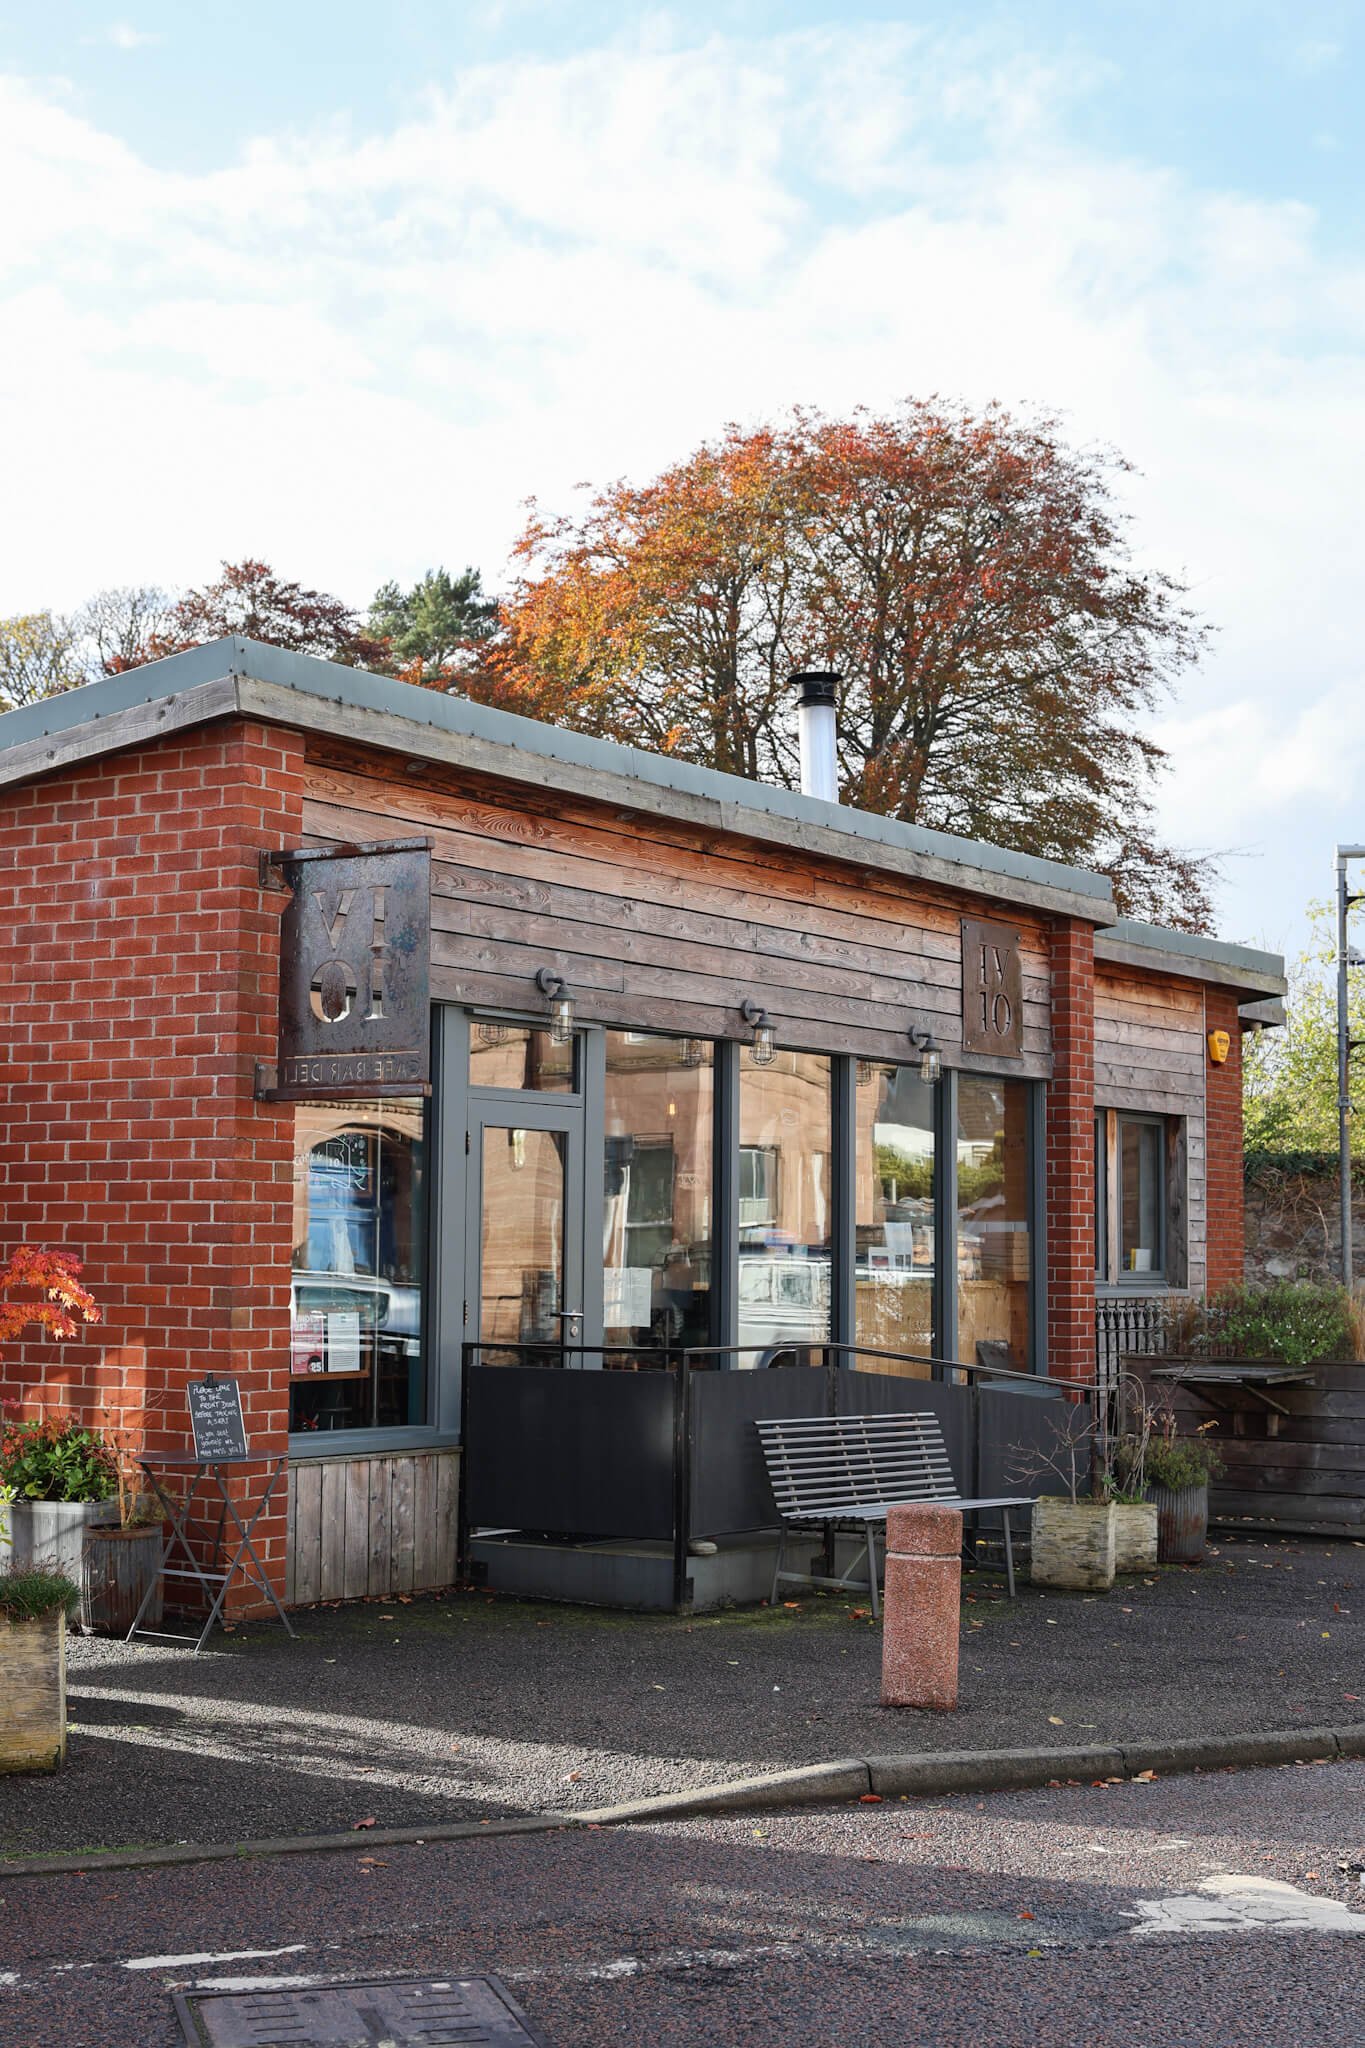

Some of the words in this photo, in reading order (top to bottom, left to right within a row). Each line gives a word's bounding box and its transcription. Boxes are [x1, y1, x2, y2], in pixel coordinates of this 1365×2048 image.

[979, 944, 1010, 986] IV
[979, 991, 1011, 1035] 10
[198, 1394, 206, 1402] TO
[208, 1392, 222, 1401] THE
